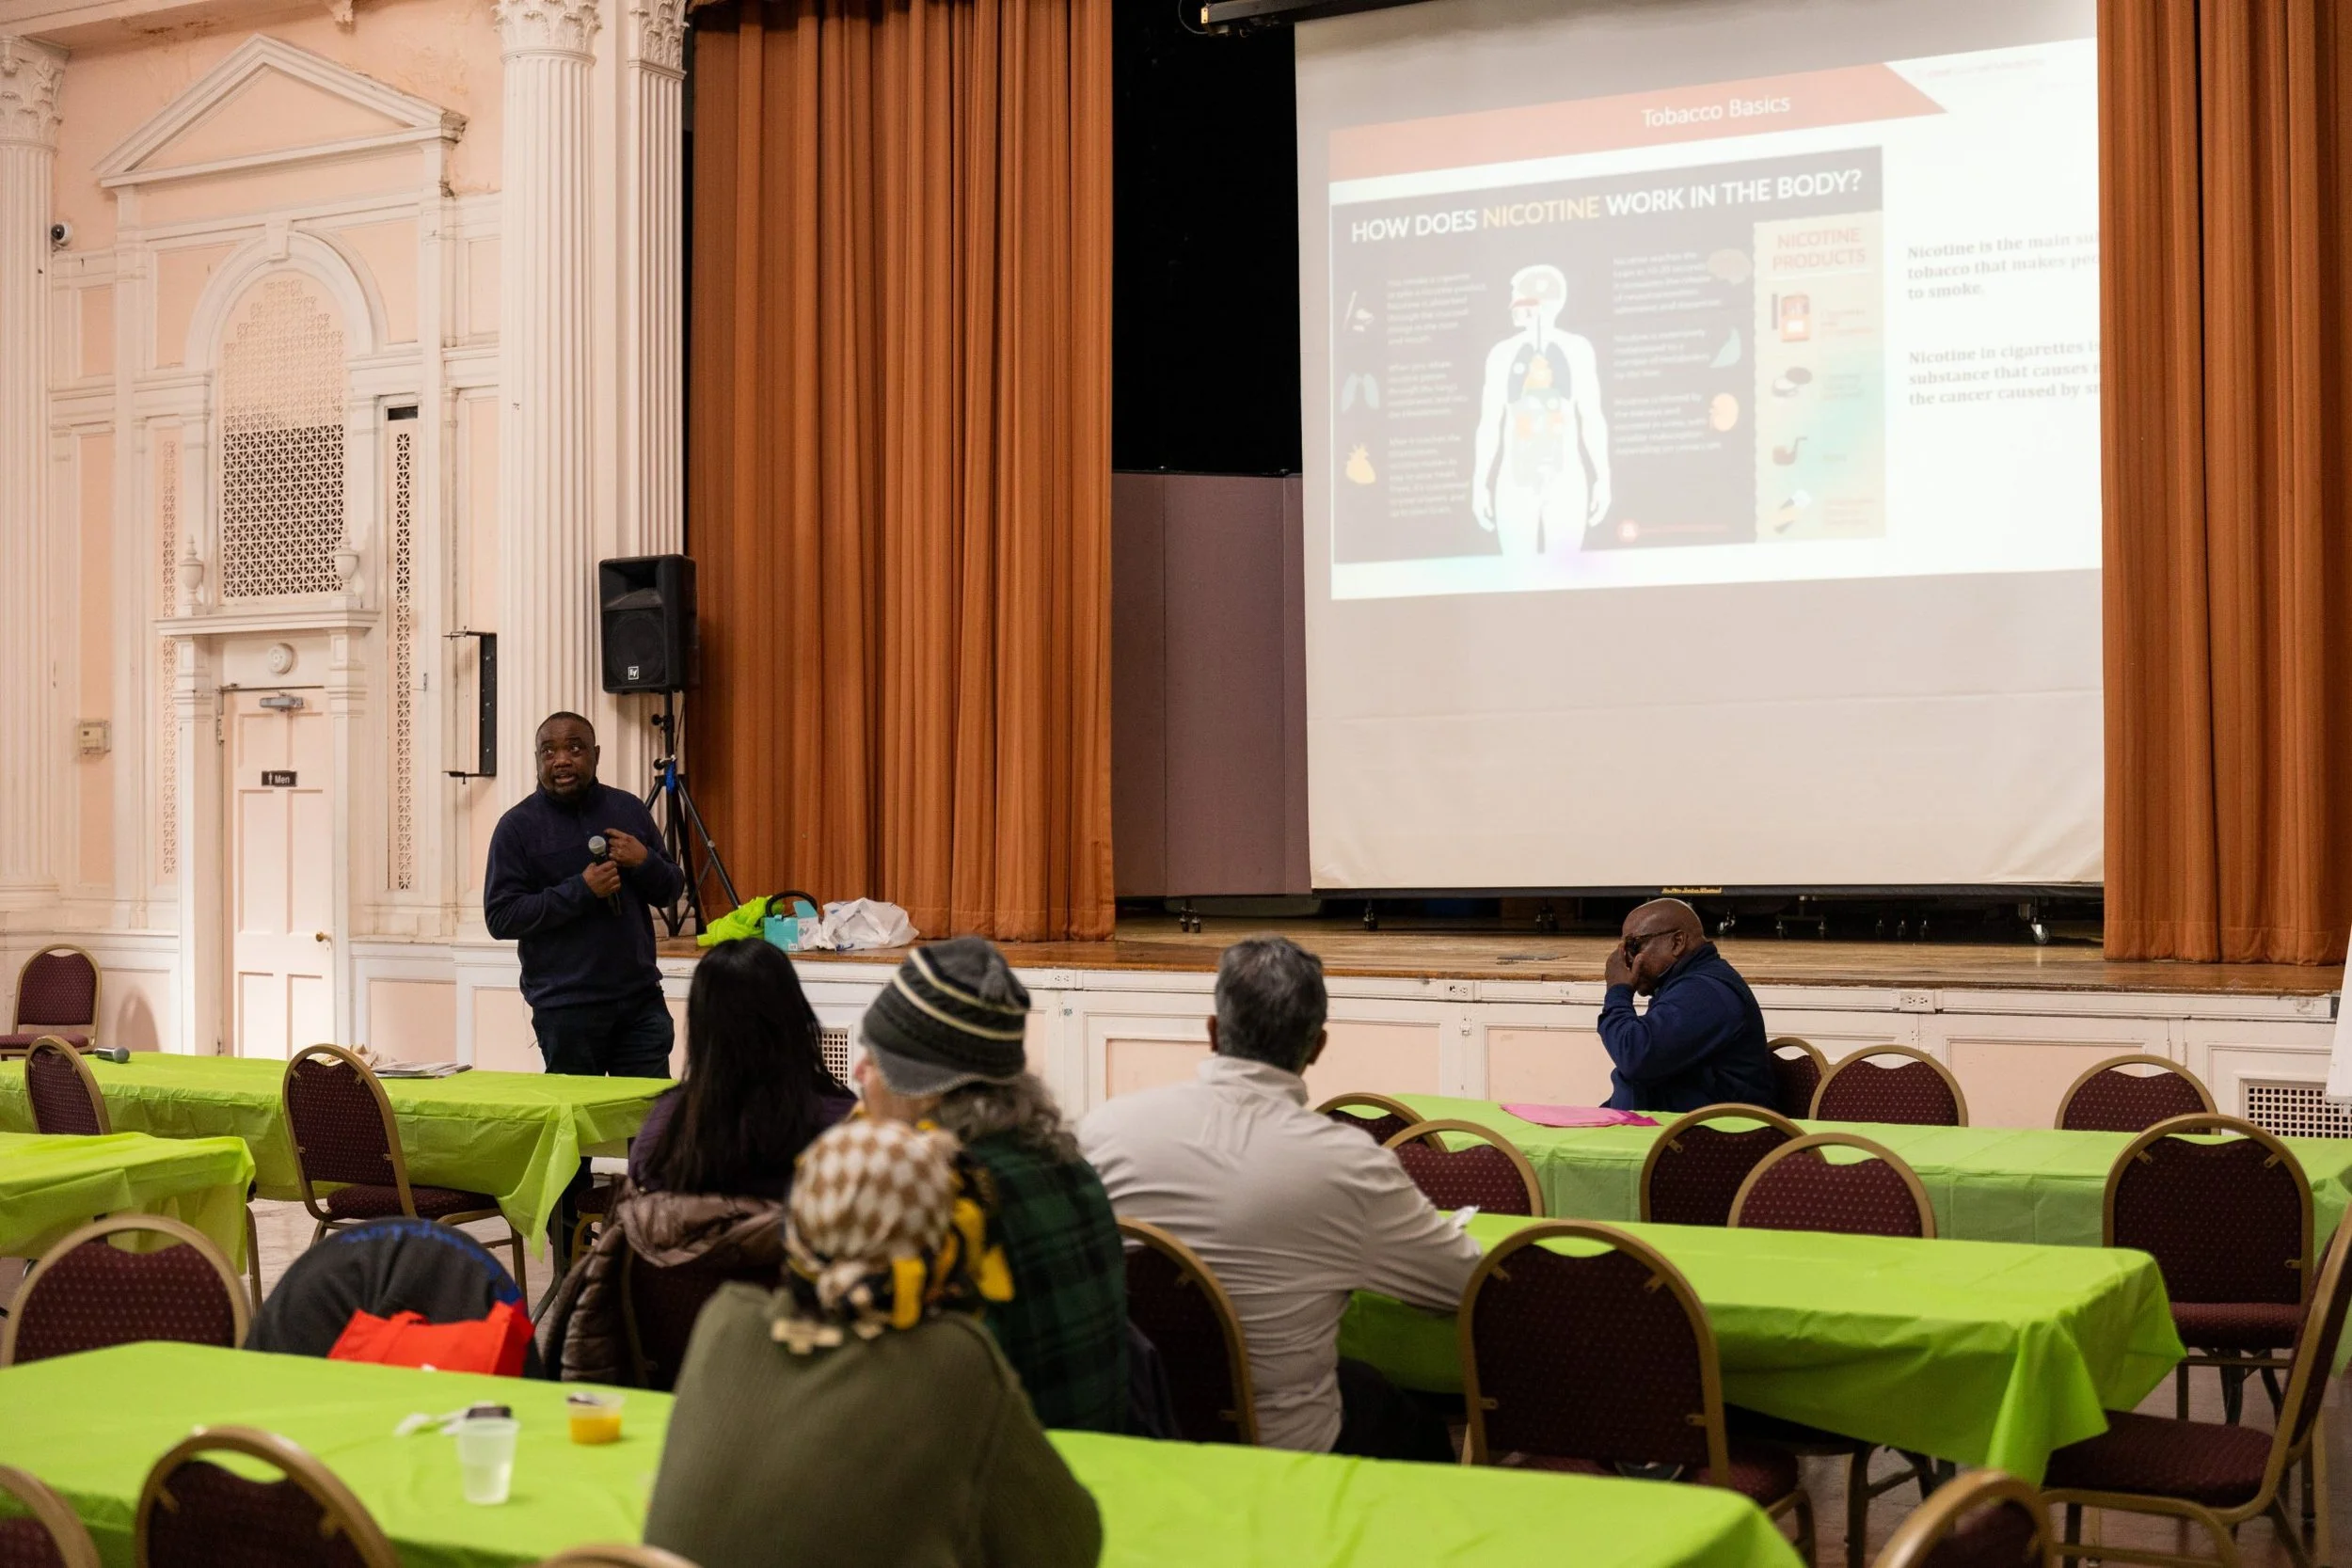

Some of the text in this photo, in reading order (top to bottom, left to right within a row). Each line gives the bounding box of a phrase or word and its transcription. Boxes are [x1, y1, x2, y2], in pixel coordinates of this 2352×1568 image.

[1641, 96, 1790, 128] Tobacco Basics
[1351, 169, 1862, 244] HOW DOES NICOTINE WORK IN THE BODY?
[1777, 228, 1861, 249] NICOTINE
[1908, 242, 1975, 260] Nicotine
[1979, 240, 1993, 254] is
[1997, 236, 2023, 251] the
[2028, 233, 2070, 248] main
[1772, 249, 1866, 271] PRODUCTS
[1908, 261, 1970, 280] tobacco
[1975, 258, 2007, 275] that
[2012, 254, 2065, 271] makes
[1908, 286, 1923, 301] to
[1909, 347, 1976, 365] Nicotine
[1981, 346, 1994, 359] in
[2001, 341, 2083, 360] cigarettes
[1909, 369, 1990, 386] substance
[1994, 365, 2027, 380] that
[2033, 364, 2089, 378] causes
[1909, 391, 1935, 406] the
[1940, 389, 1993, 404] cancer
[1998, 384, 2056, 400] caused
[2061, 382, 2080, 399] by
[274, 774, 291, 784] Men
